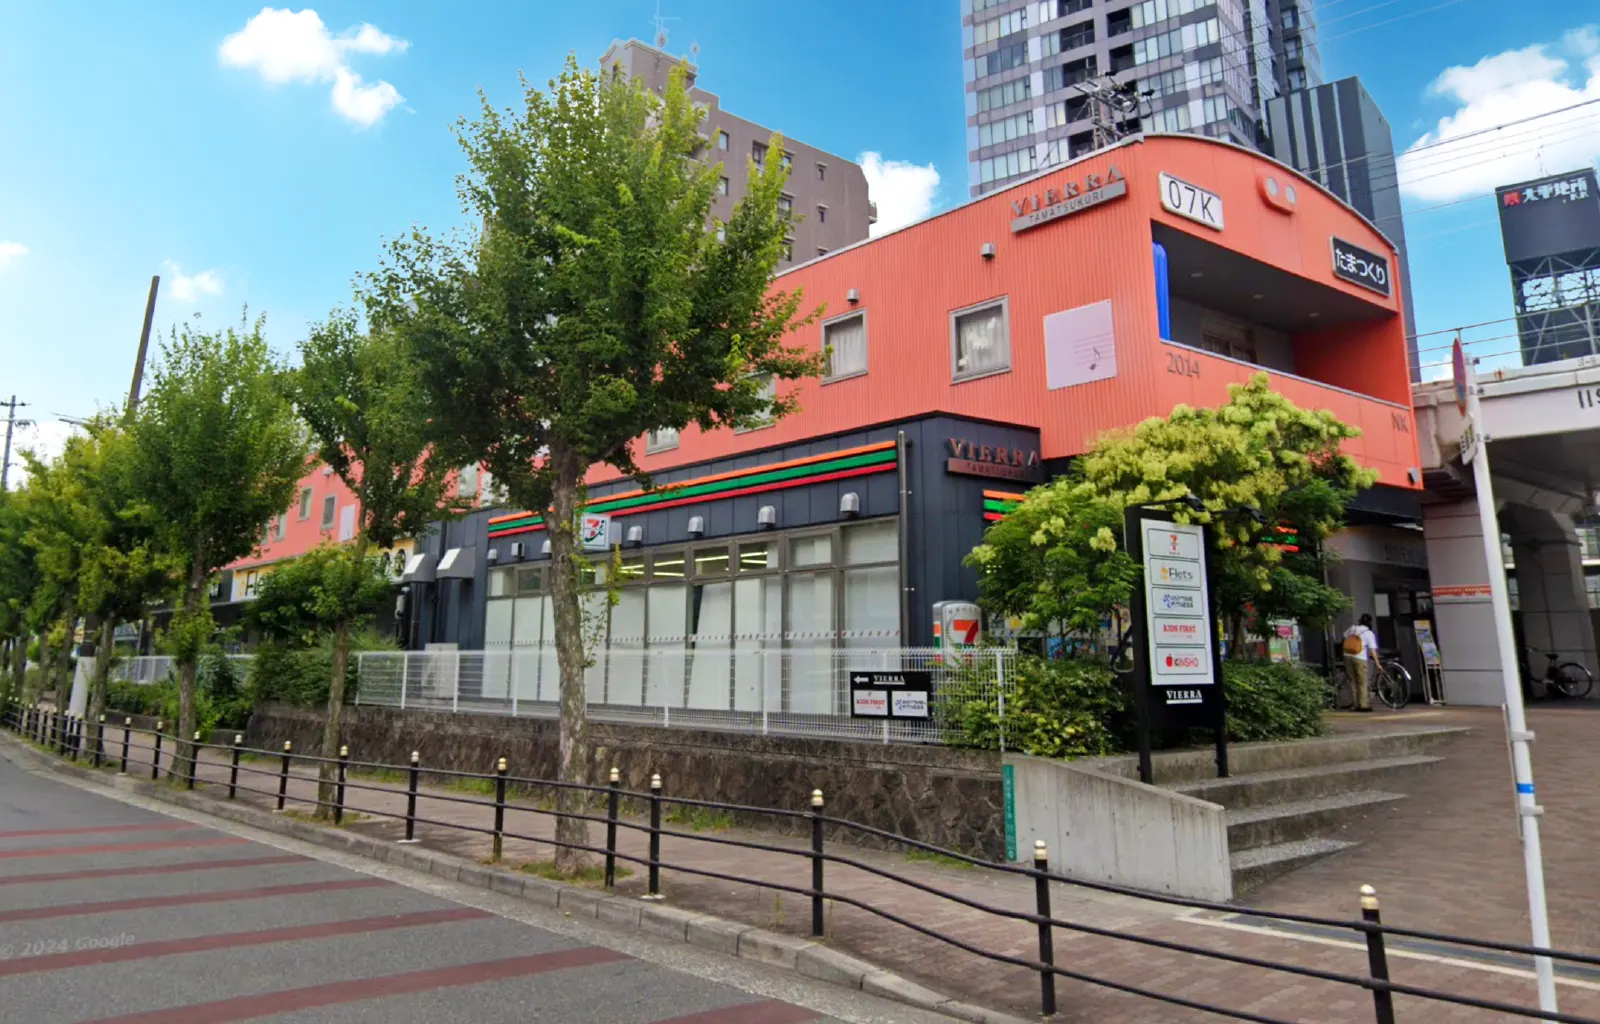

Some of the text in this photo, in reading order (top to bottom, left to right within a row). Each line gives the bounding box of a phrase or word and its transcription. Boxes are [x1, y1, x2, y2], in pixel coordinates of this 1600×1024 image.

[1011, 164, 1125, 217] VIERRA
[1168, 180, 1215, 223] 07K
[1029, 192, 1105, 224] TAMATSUKURI
[1335, 248, 1386, 285] たまつくり
[1166, 351, 1200, 379] 2014
[947, 437, 1040, 467] VIERRA
[873, 674, 906, 682] VIERRA
[1166, 689, 1203, 700] VIERRA
